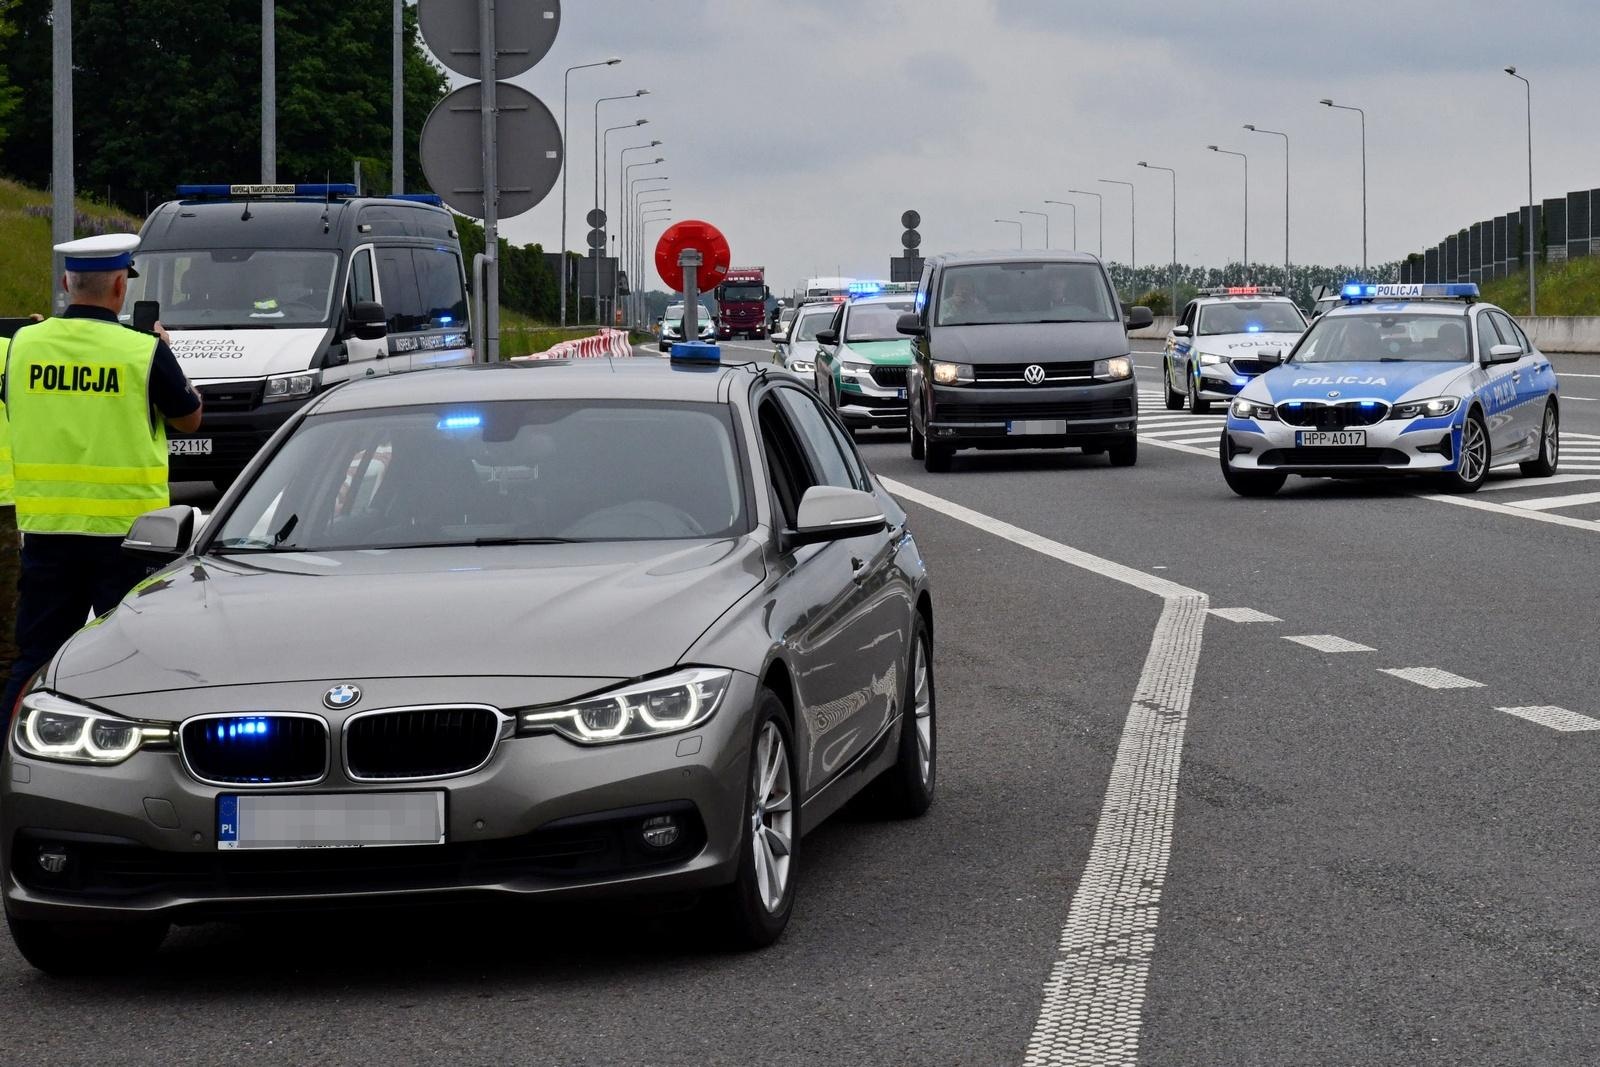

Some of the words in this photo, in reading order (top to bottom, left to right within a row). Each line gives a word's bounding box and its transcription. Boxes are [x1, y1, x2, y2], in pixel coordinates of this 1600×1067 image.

[1377, 285, 1420, 296] POLICJA
[29, 364, 120, 393] POLICJA
[1292, 376, 1388, 387] POLICJA
[1304, 432, 1327, 445] HPP
[1331, 432, 1362, 445] A017
[171, 440, 209, 452] 5211K
[221, 823, 235, 834] PL
